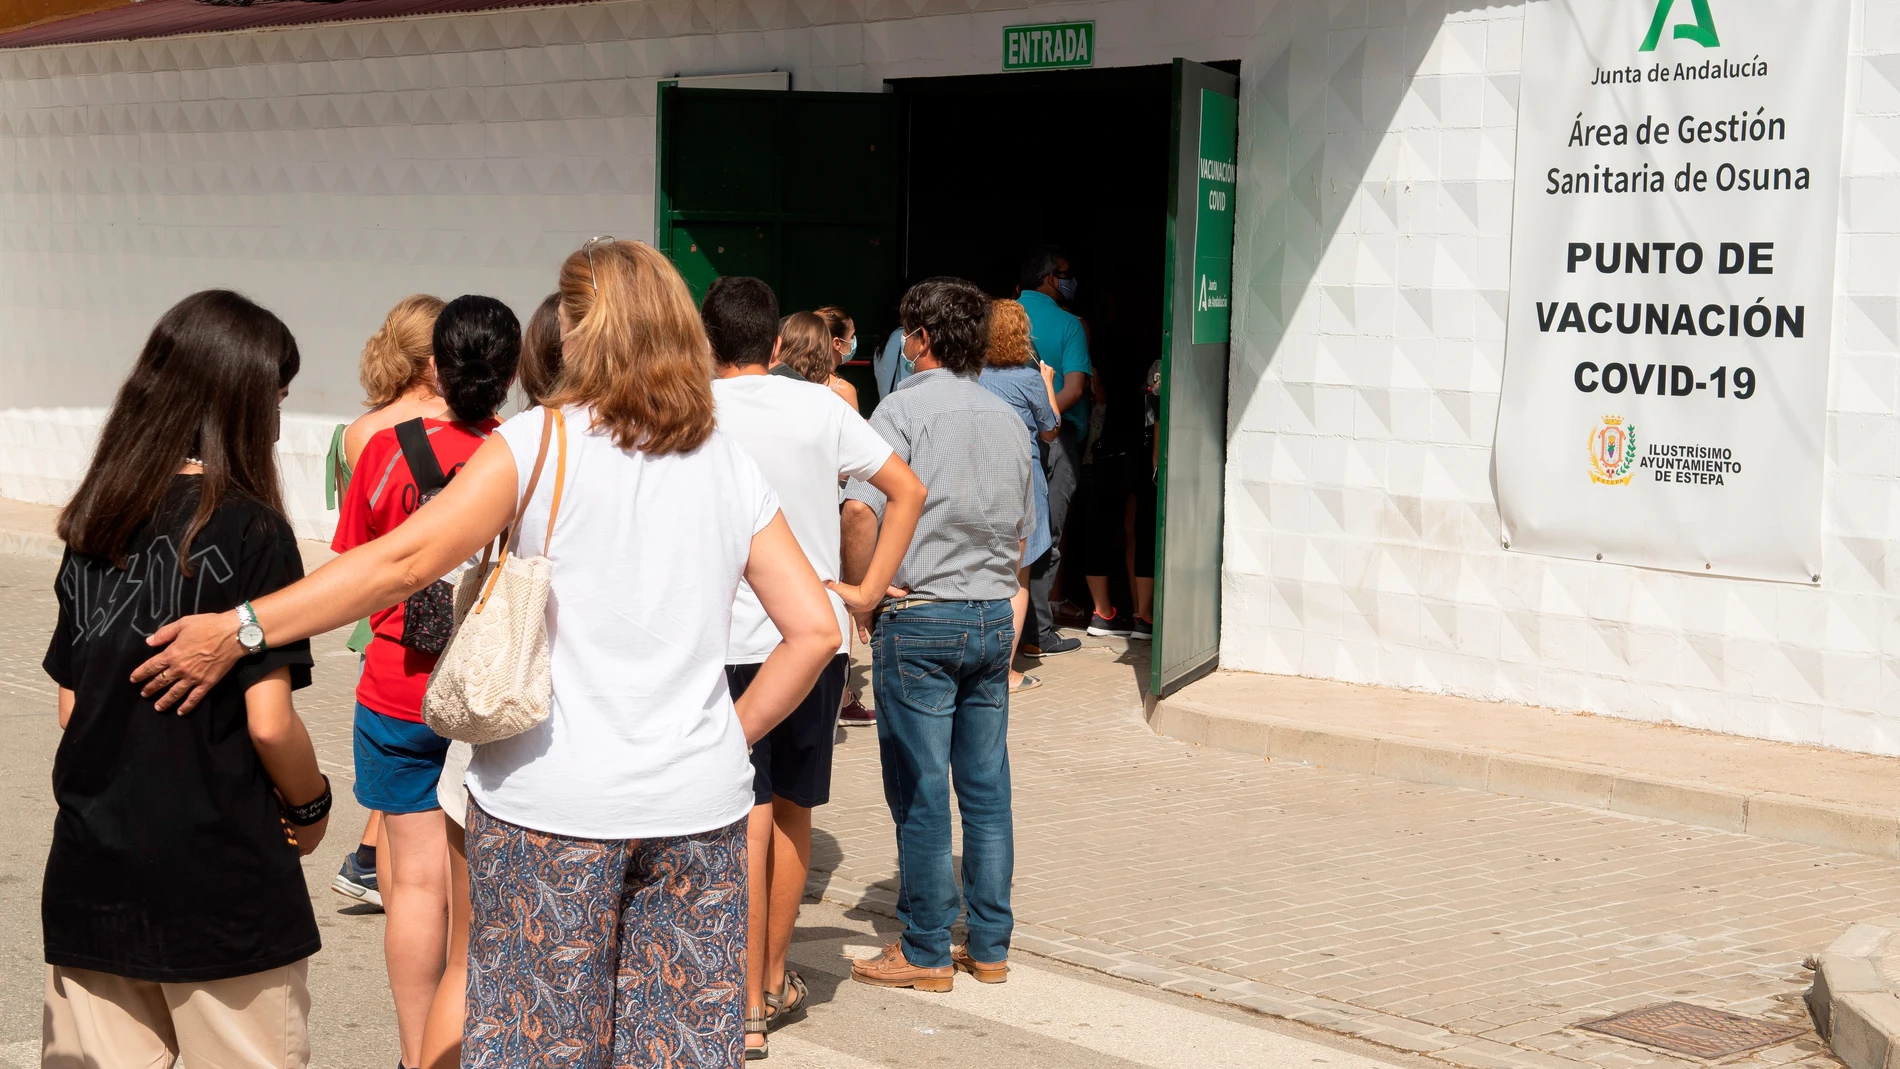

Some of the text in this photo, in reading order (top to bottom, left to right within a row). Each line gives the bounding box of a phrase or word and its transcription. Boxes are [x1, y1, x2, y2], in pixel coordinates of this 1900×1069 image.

[1008, 28, 1088, 65] ENTRADA
[1591, 54, 1768, 86] Junta de Andalucía
[1568, 106, 1786, 148] Área de Gestión
[1200, 157, 1236, 184] VACUNACIÓN
[1546, 162, 1810, 195] Sanitaria de Osuna
[1208, 189, 1226, 212] COVID
[1566, 241, 1775, 275] PUNTO DE
[1536, 296, 1805, 338] VACUNACIÓN
[1574, 361, 1756, 400] COVID-19
[1640, 456, 1742, 474] AYUNTAMIENTO
[1648, 443, 1732, 460] ILUSTRÍSIMO
[1596, 476, 1625, 485] ESTEPA
[1655, 470, 1725, 486] DE ESTEPA
